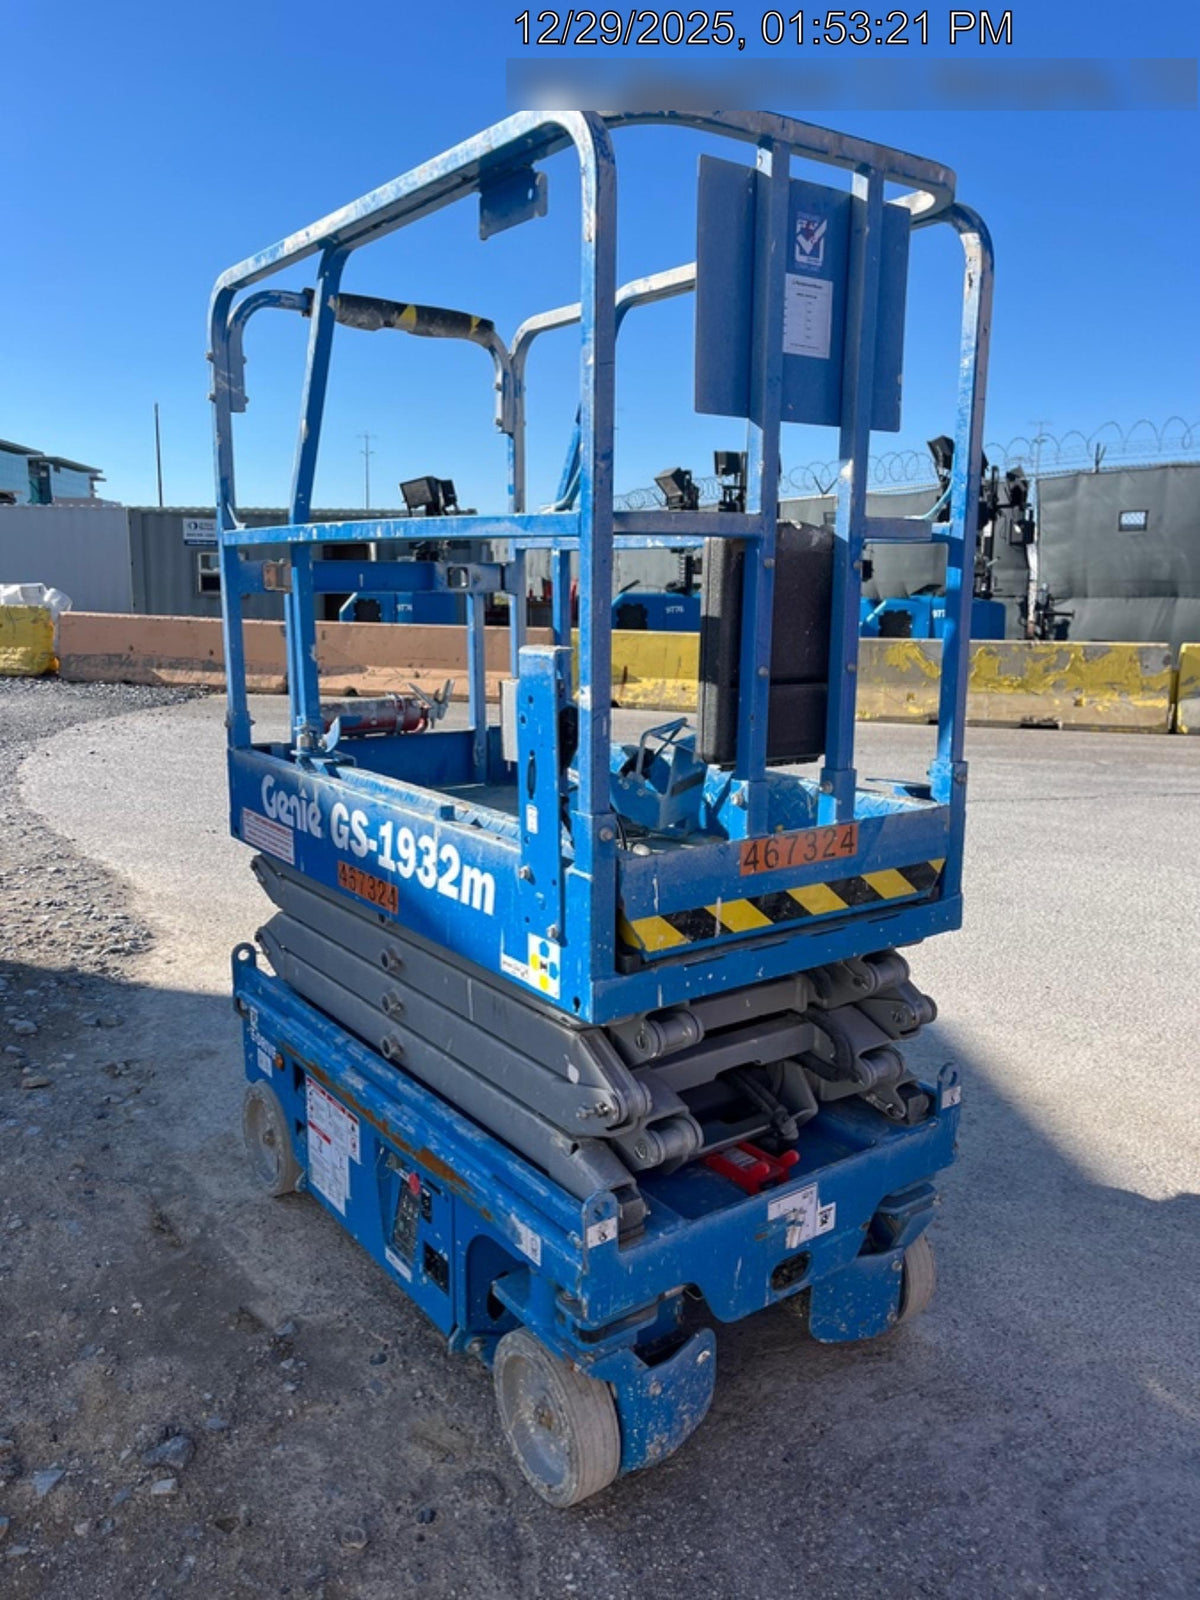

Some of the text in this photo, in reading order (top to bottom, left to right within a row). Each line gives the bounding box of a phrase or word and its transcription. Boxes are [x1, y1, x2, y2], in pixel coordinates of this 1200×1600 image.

[261, 774, 323, 839] Genie
[329, 802, 496, 916] GS-1932m
[742, 824, 855, 872] 467324
